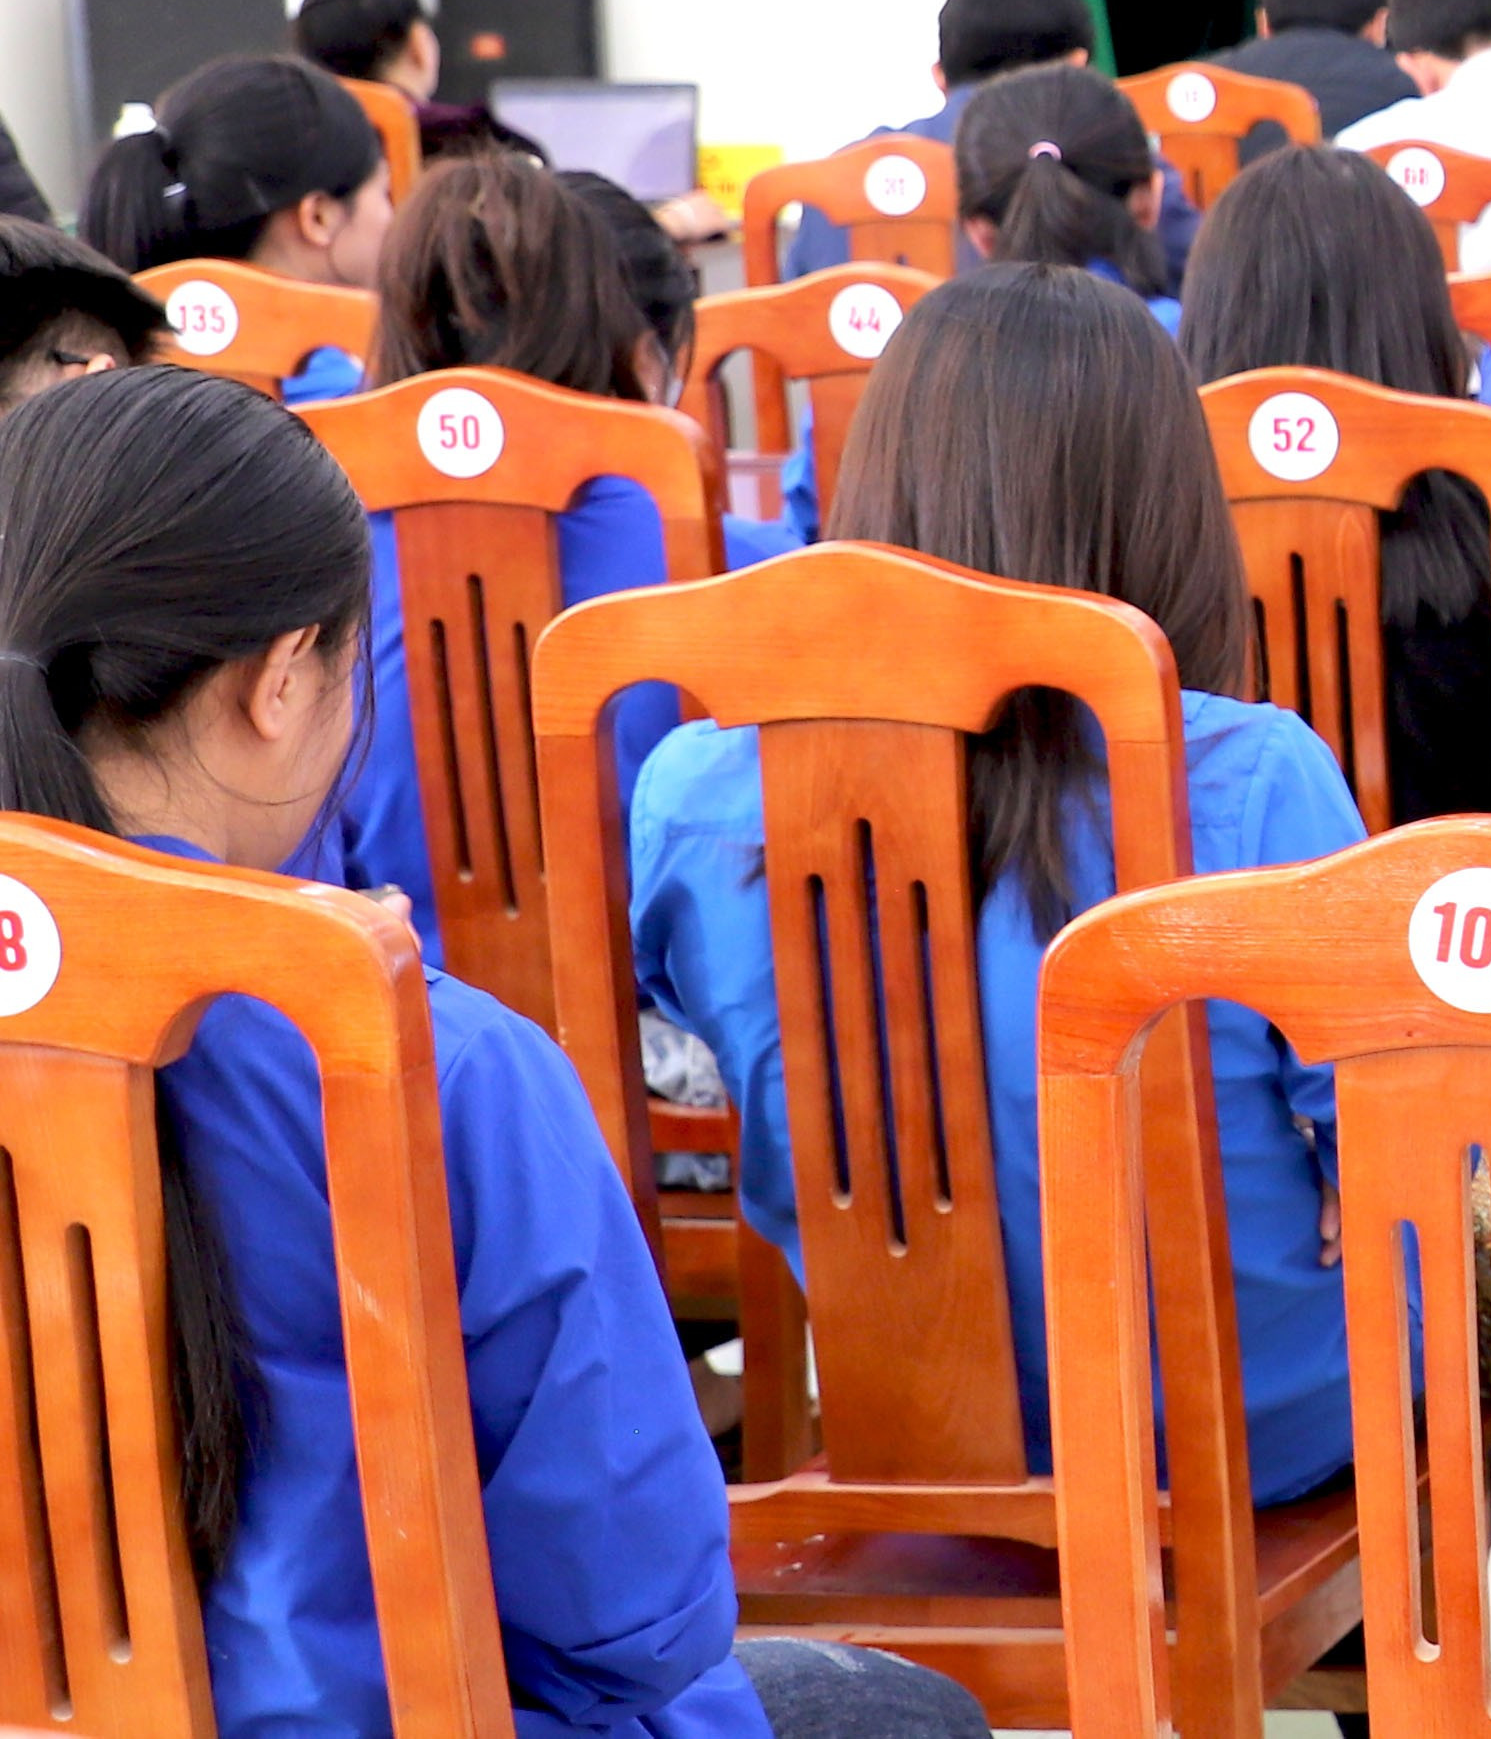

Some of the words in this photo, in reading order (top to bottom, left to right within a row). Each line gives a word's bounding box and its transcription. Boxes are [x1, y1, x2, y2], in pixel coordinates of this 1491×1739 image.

[177, 304, 226, 334] 135
[847, 306, 883, 335] 44
[439, 415, 481, 451] 50
[1273, 418, 1316, 452] 52
